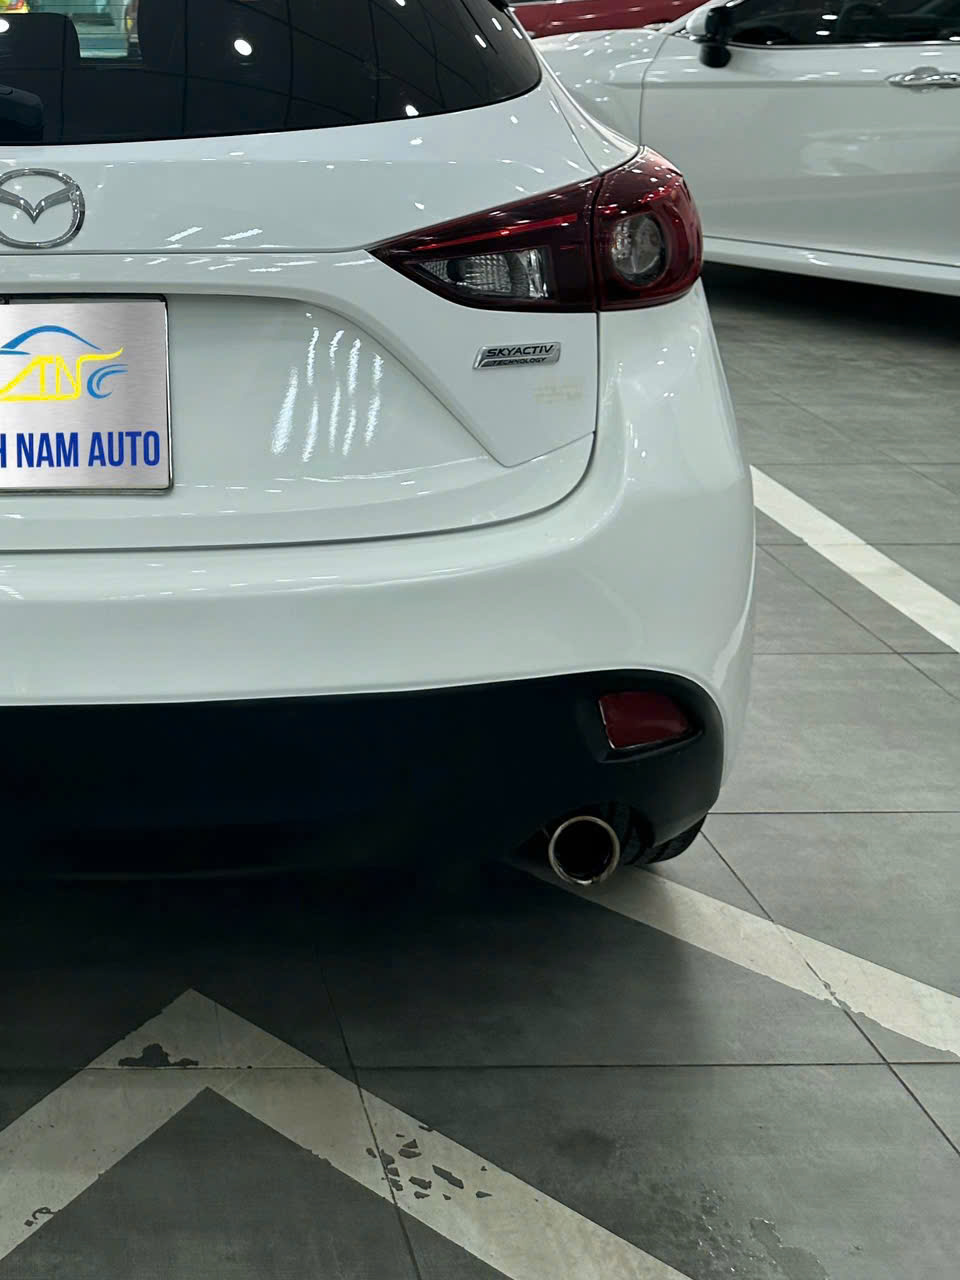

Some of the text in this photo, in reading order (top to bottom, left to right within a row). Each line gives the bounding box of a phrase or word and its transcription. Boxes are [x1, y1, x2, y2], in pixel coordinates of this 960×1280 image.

[487, 345, 554, 357] SKYACTIV
[16, 433, 79, 468] NAM
[88, 431, 160, 467] AUTO
